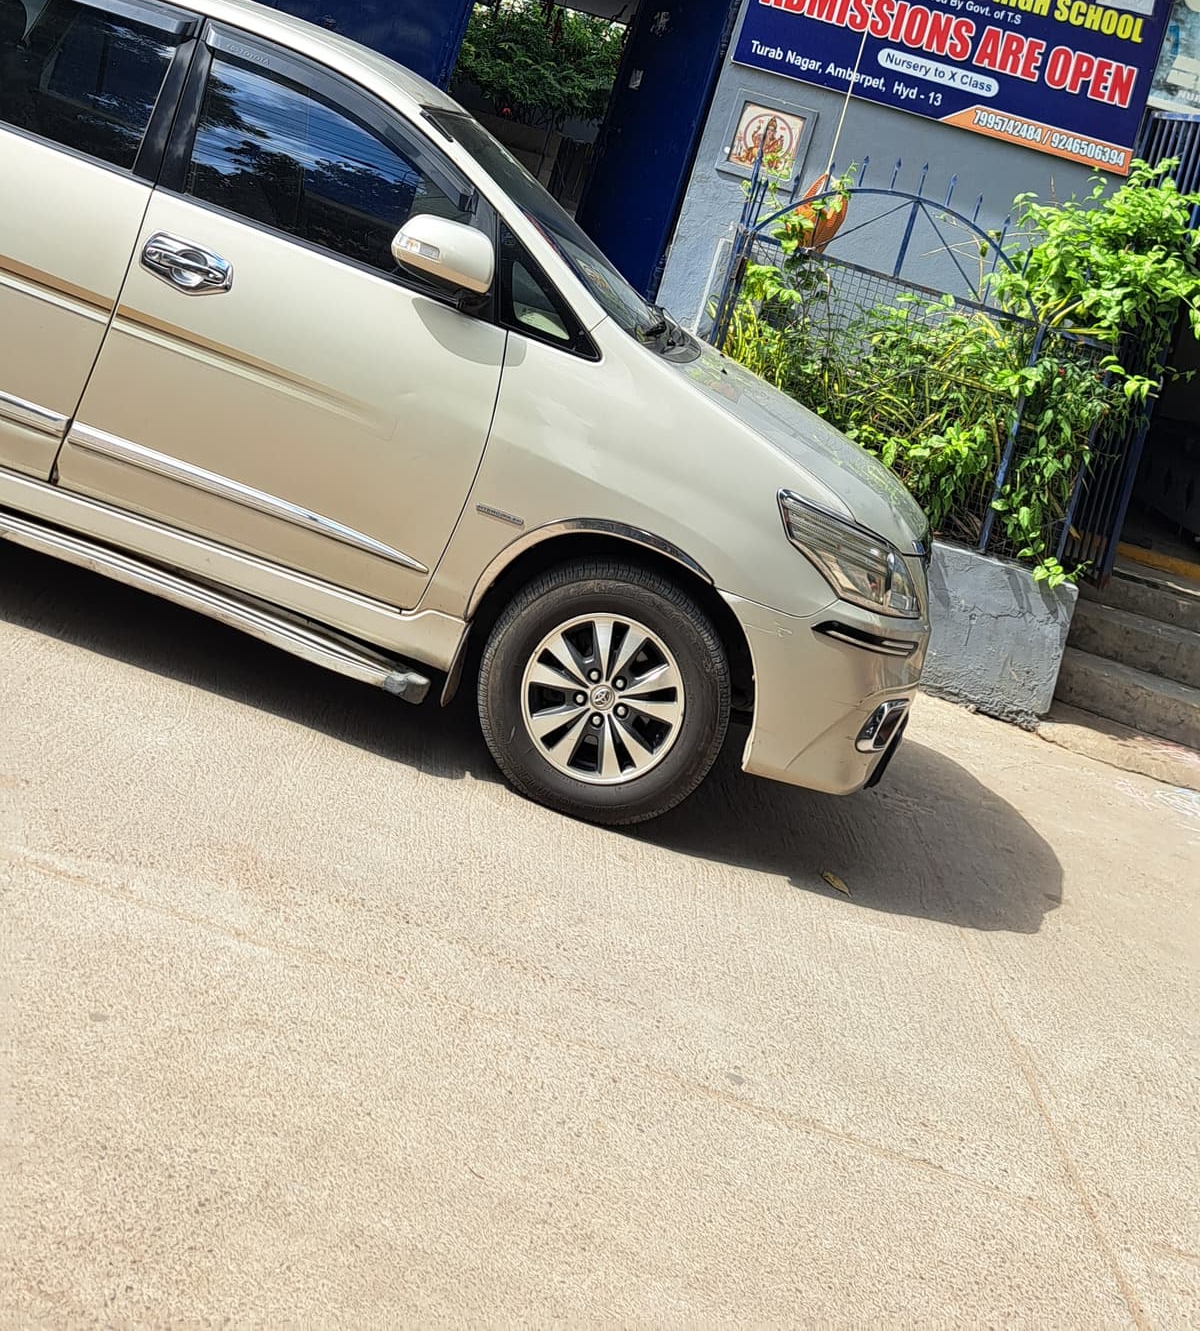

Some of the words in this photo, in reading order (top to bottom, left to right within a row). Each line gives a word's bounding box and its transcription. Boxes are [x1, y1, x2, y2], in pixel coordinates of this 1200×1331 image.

[966, 0, 991, 17] Govt.
[993, 8, 1006, 21] of
[1006, 11, 1022, 25] T.S
[751, 40, 783, 61] Turab
[785, 50, 823, 73] Nagar,
[825, 63, 887, 92] Amberpet,
[892, 81, 918, 102] Hyd
[928, 92, 943, 107] 13
[885, 52, 931, 77] Nursery
[934, 65, 946, 79] to
[947, 69, 957, 82] X
[961, 75, 992, 93] Class
[972, 25, 1047, 82] ARE
[1044, 45, 1138, 109] OPEN
[973, 109, 1043, 143] 7995742484
[1050, 132, 1125, 167] 9246506394
